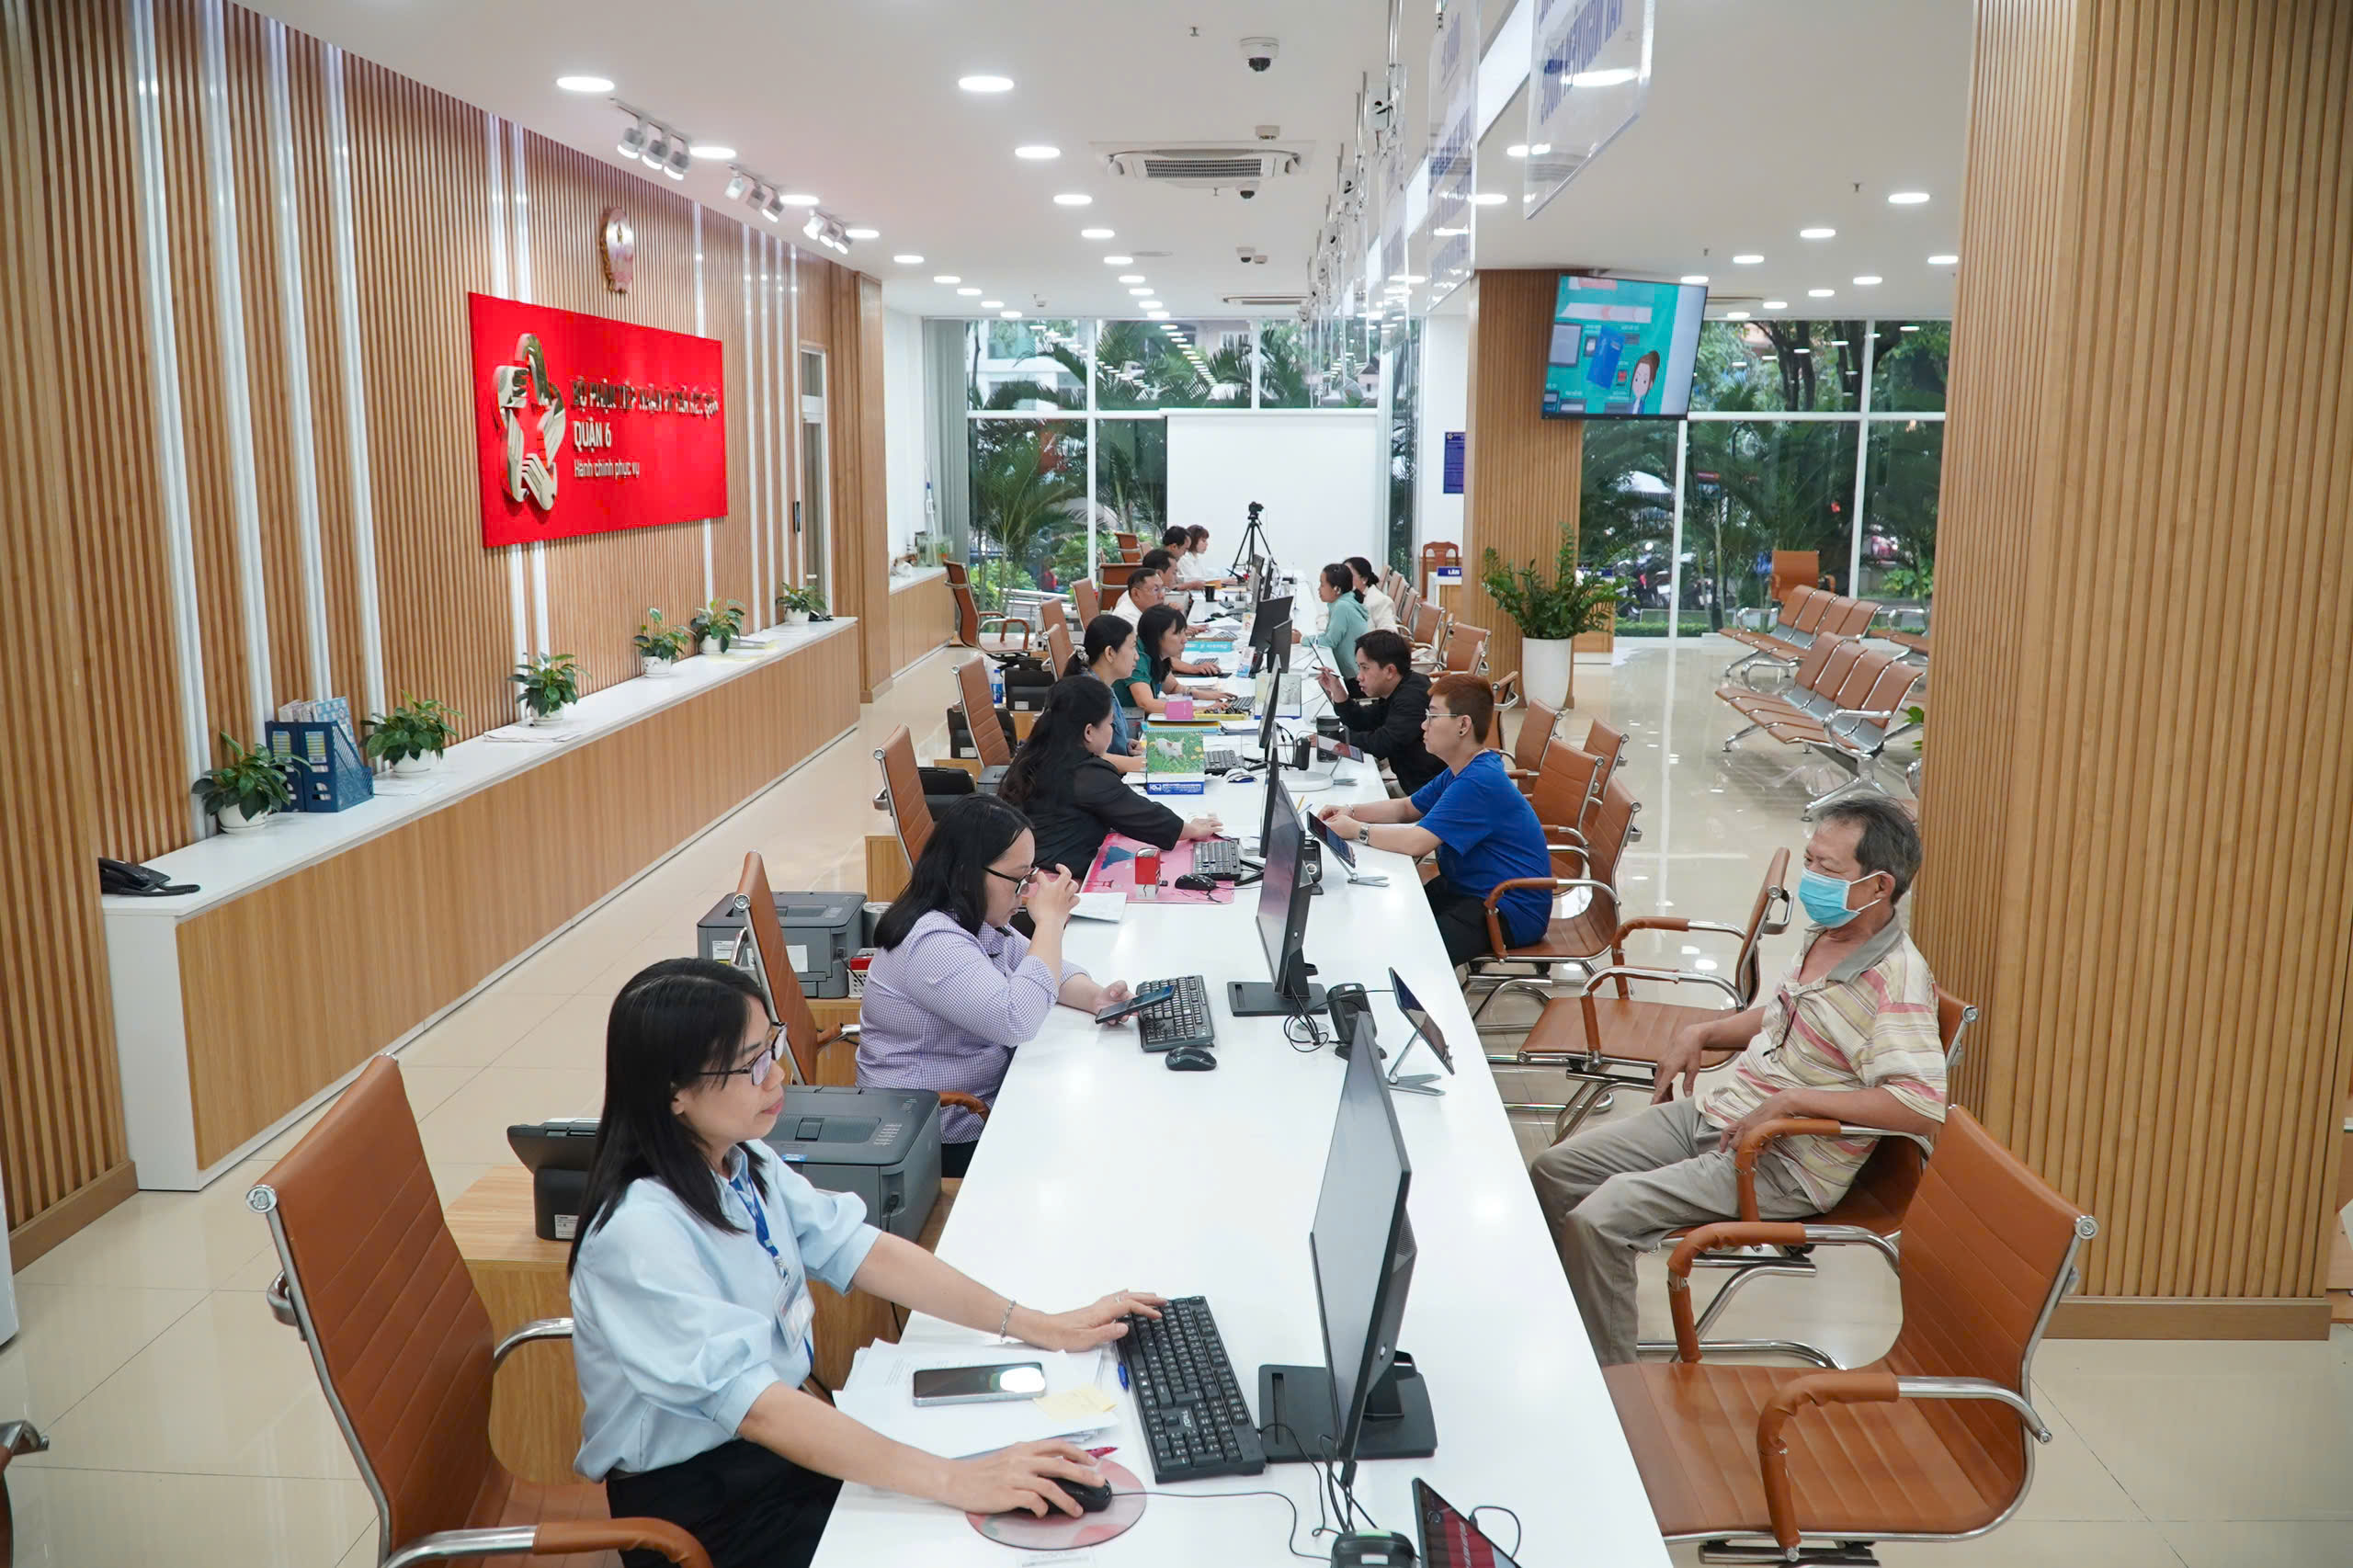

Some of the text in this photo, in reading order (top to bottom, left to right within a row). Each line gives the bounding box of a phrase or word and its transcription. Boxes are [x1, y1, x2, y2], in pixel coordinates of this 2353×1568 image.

[574, 416, 611, 452] QUẬN 6
[614, 459, 631, 481] phục
